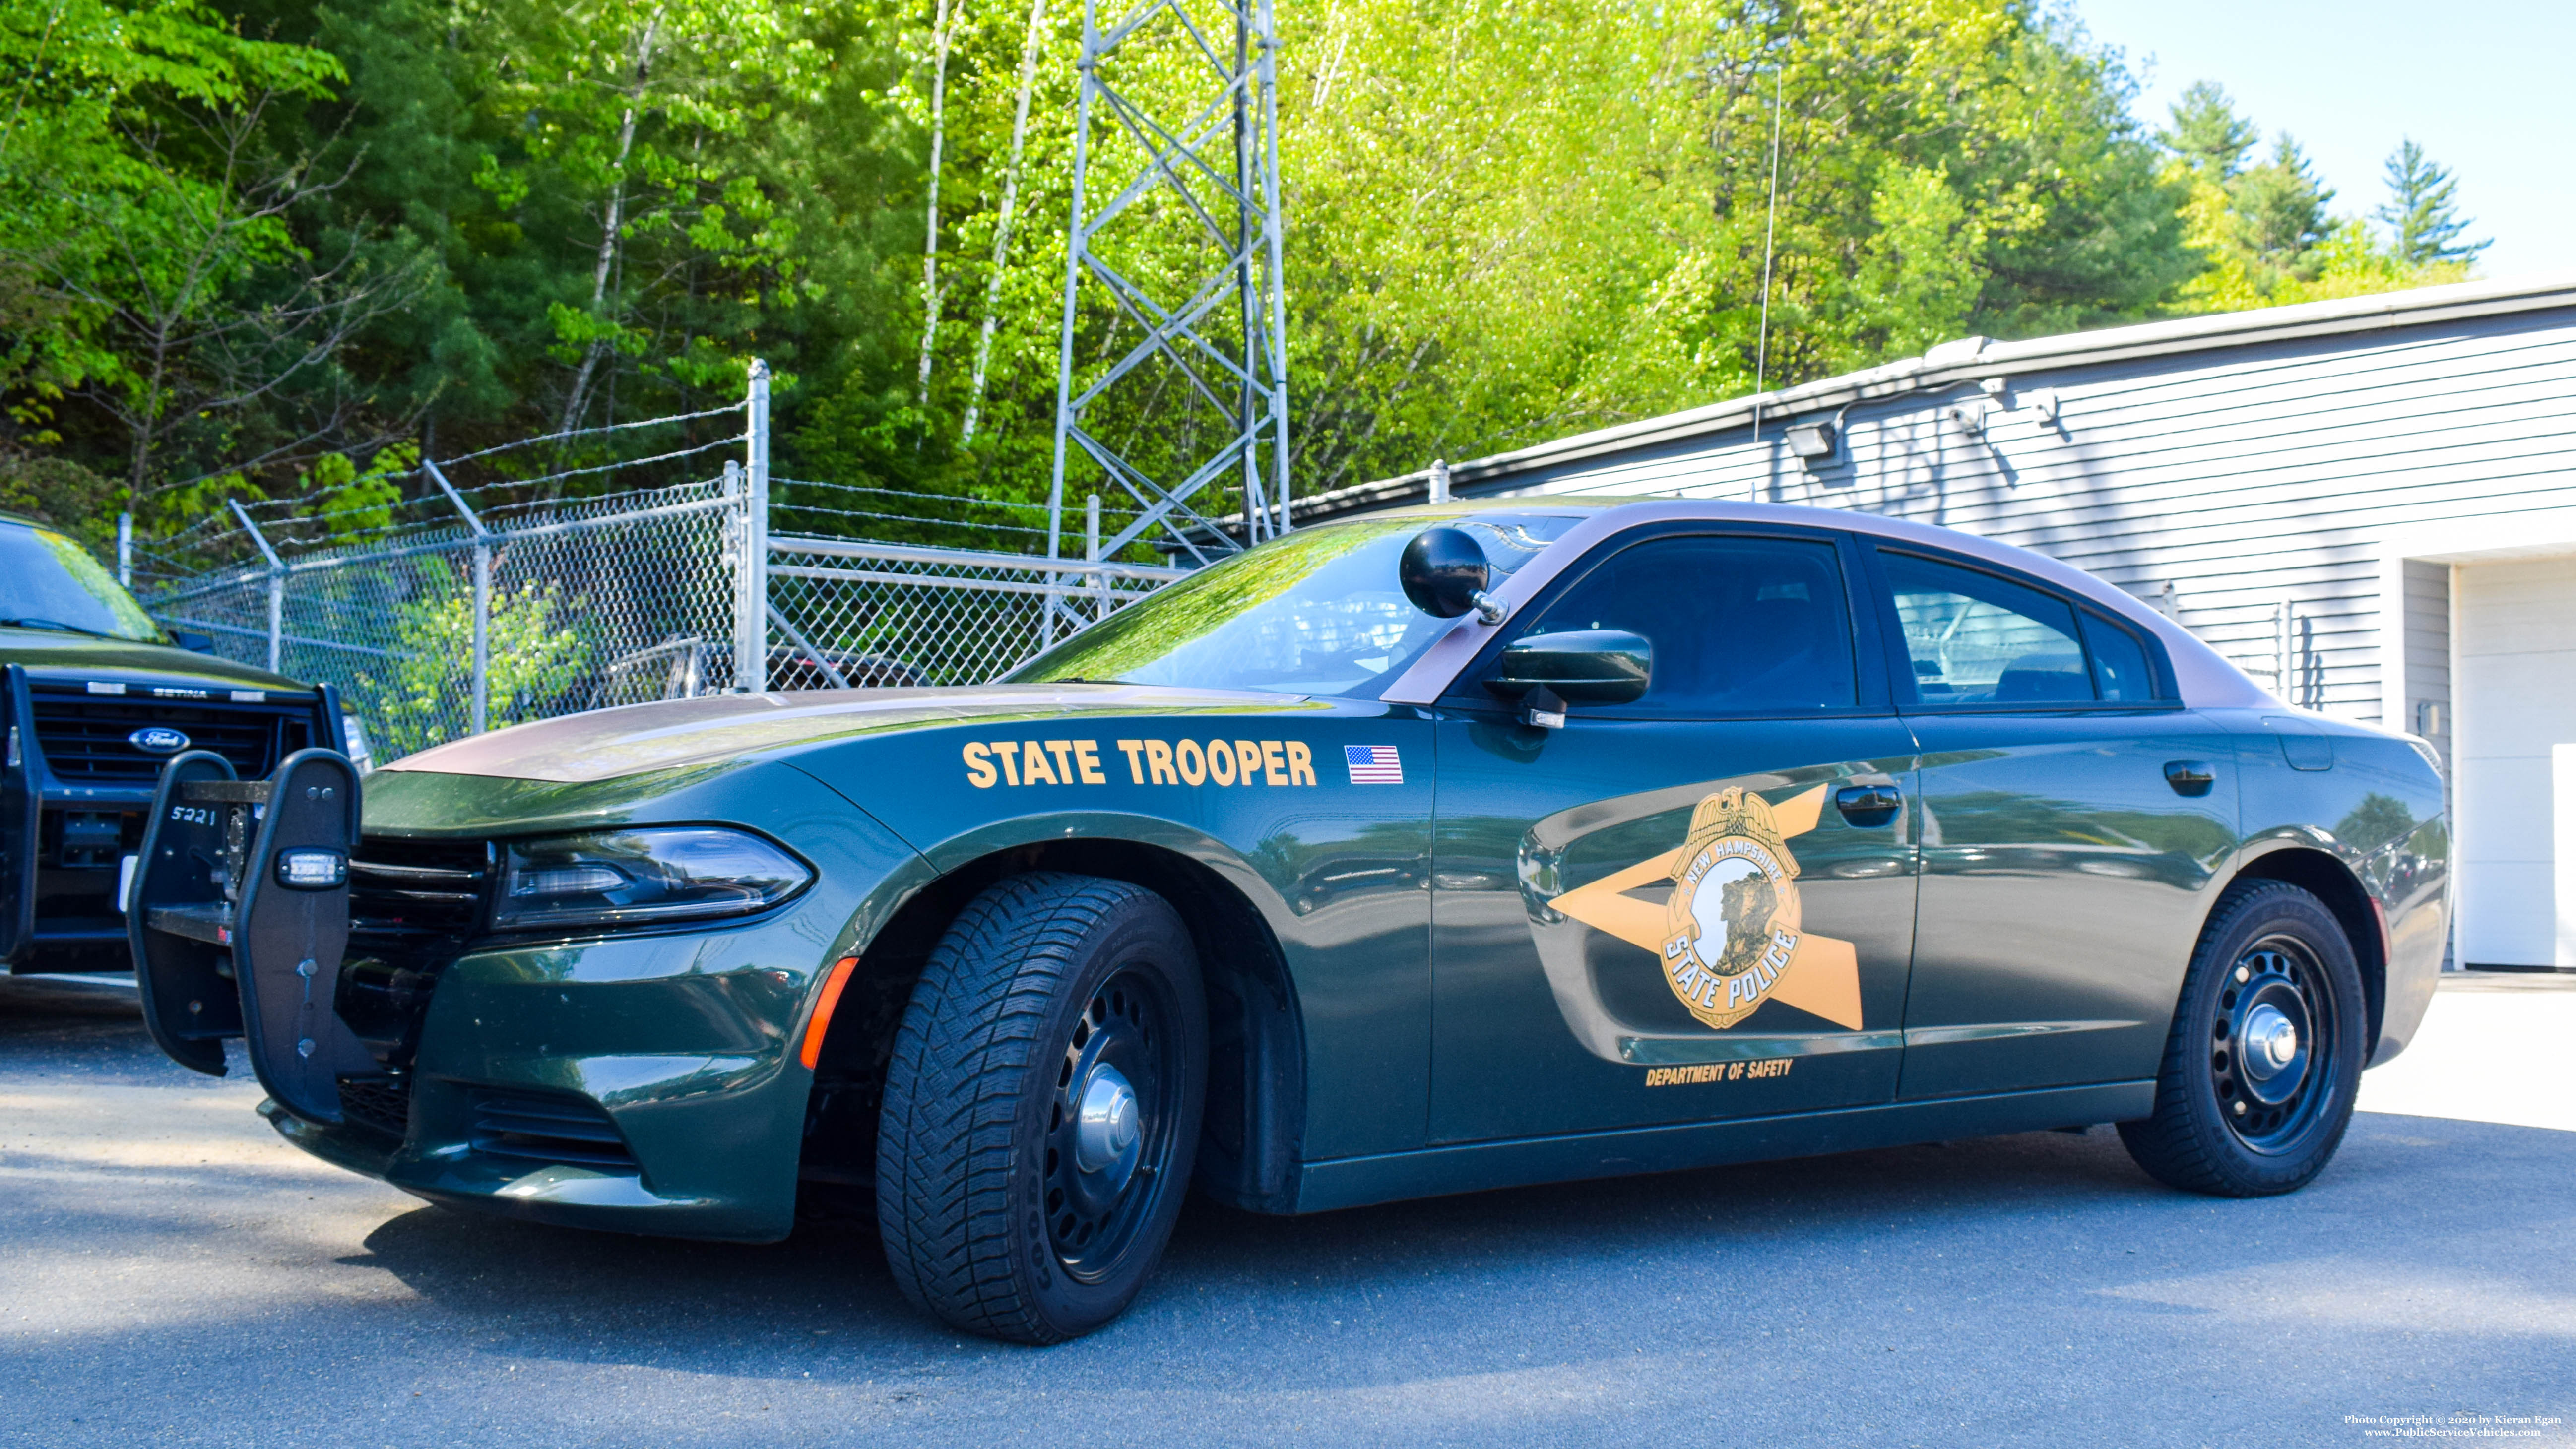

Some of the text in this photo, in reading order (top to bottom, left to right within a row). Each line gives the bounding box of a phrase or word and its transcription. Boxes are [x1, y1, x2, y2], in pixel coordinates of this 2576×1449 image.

[145, 732, 179, 746] Ford
[963, 739, 1315, 789] STATE TROOPER
[170, 805, 216, 826] 5221
[1687, 840, 1783, 884] NEW HAMPSHIRE
[1666, 929, 1797, 1009] STATE POLICE
[1645, 1059, 1793, 1086] DEPARTMENT OF SAFETY
